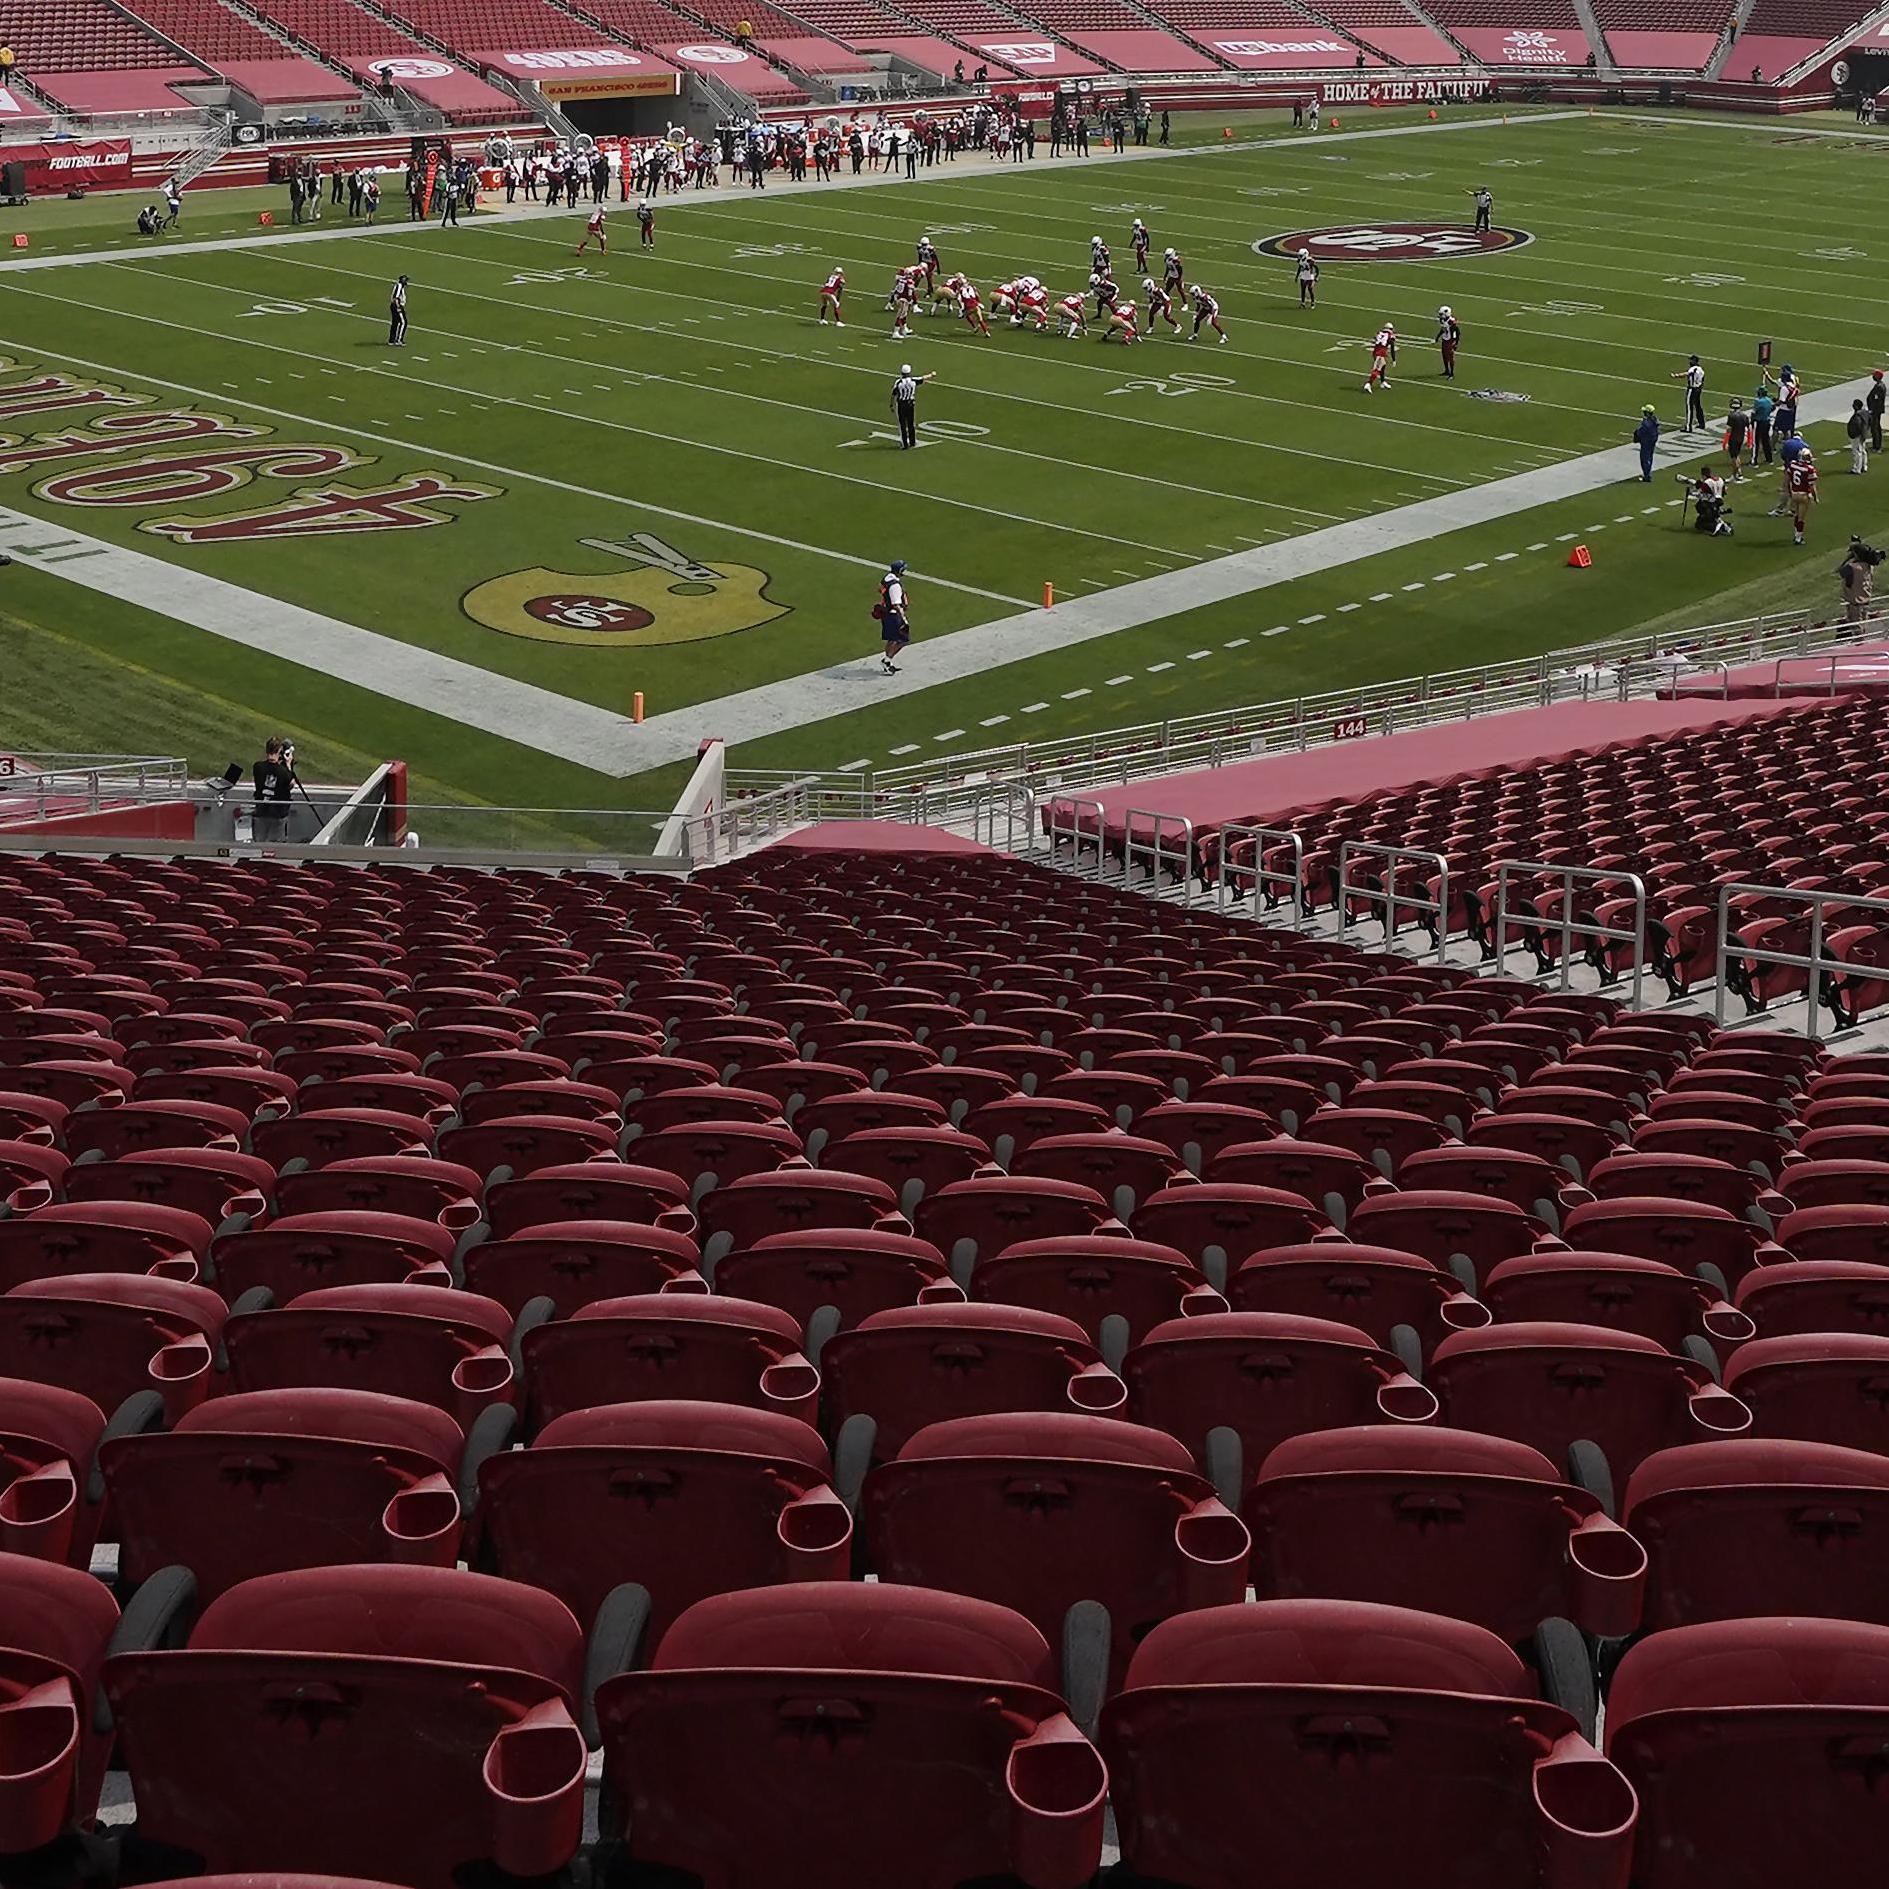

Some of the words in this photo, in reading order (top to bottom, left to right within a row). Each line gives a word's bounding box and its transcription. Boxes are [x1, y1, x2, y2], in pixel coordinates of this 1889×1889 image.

[575, 83, 636, 94] FRANCISCO
[639, 80, 668, 91] 49ERS
[1323, 83, 1369, 102] HOME
[1381, 82, 1413, 100] THE
[49, 152, 129, 170] FOOTBALL.COM
[1337, 721, 1366, 738] 144
